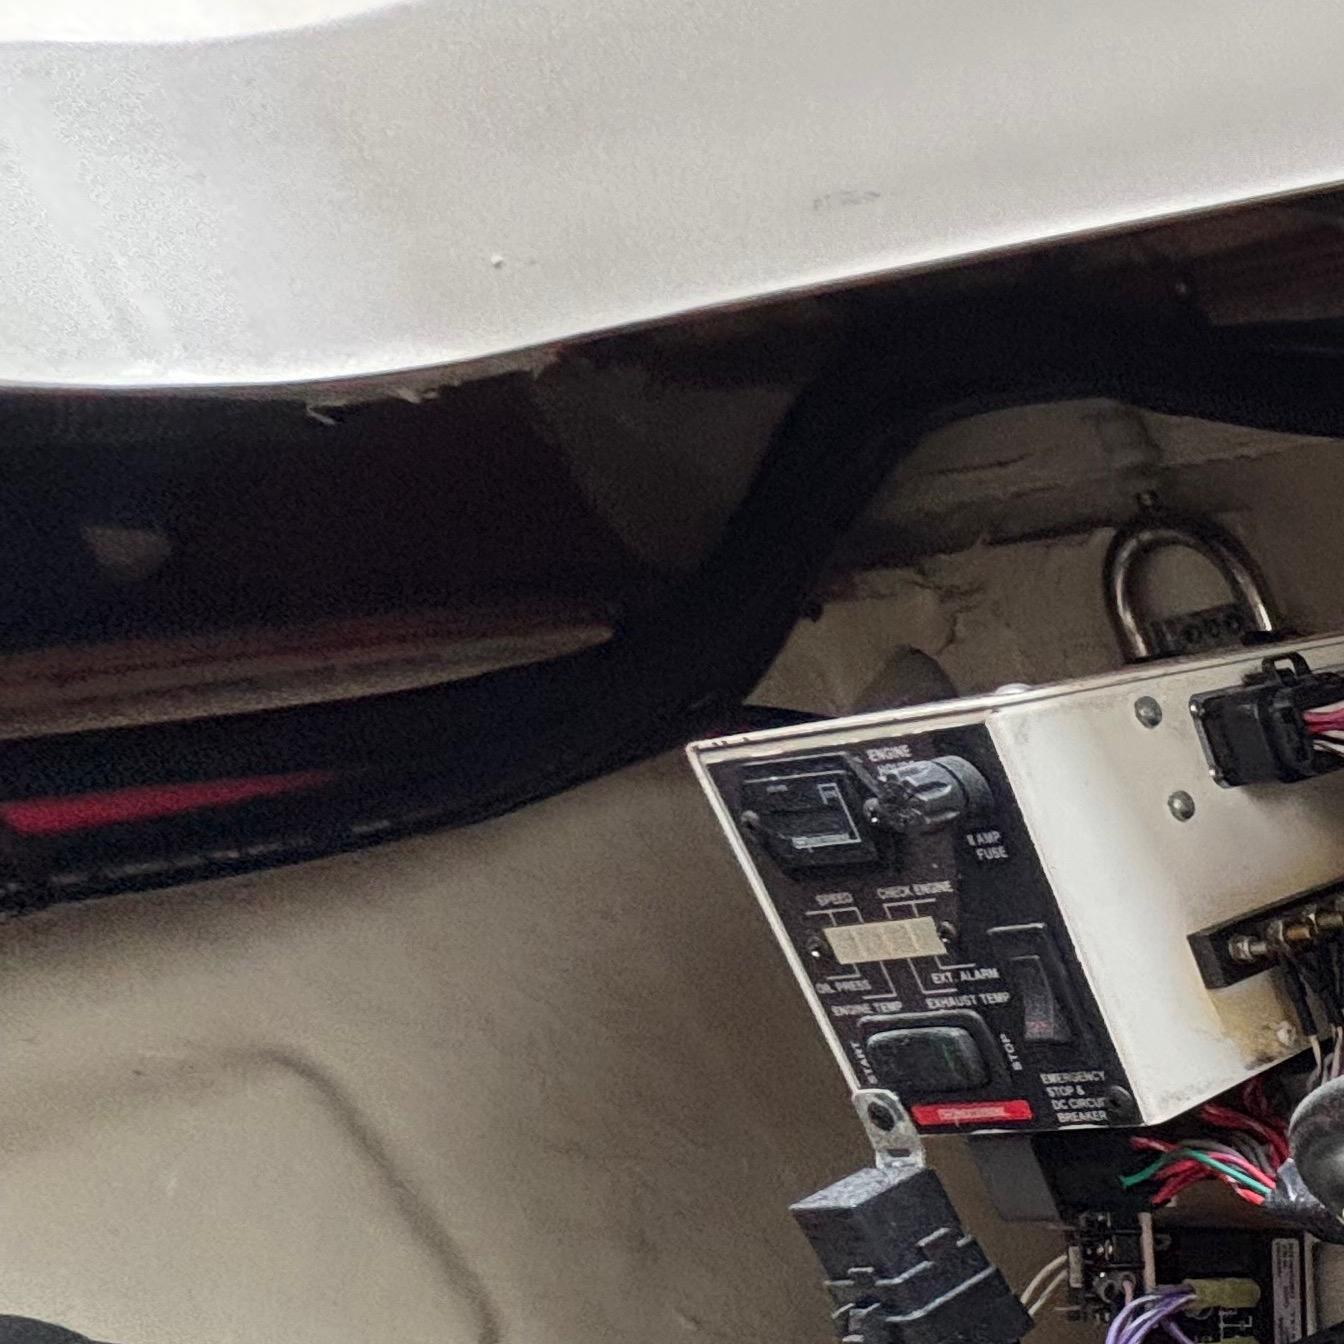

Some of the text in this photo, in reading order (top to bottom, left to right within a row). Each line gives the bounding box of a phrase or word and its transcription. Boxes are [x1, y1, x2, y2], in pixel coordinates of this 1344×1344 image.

[975, 830, 1002, 845] AMP
[976, 845, 1009, 861] FUSE
[877, 885, 914, 899] CHECK
[960, 968, 1000, 982] ALARM
[815, 979, 873, 994] OIL PRESS
[926, 991, 1011, 1009] EXHAUST TEMP
[830, 1000, 903, 1017] ENGINE TEMP
[999, 1033, 1023, 1071] STOP
[1046, 1085, 1075, 1098] STOP
[1051, 1099, 1068, 1110] DC
[1056, 1110, 1108, 1123] BREAKER
